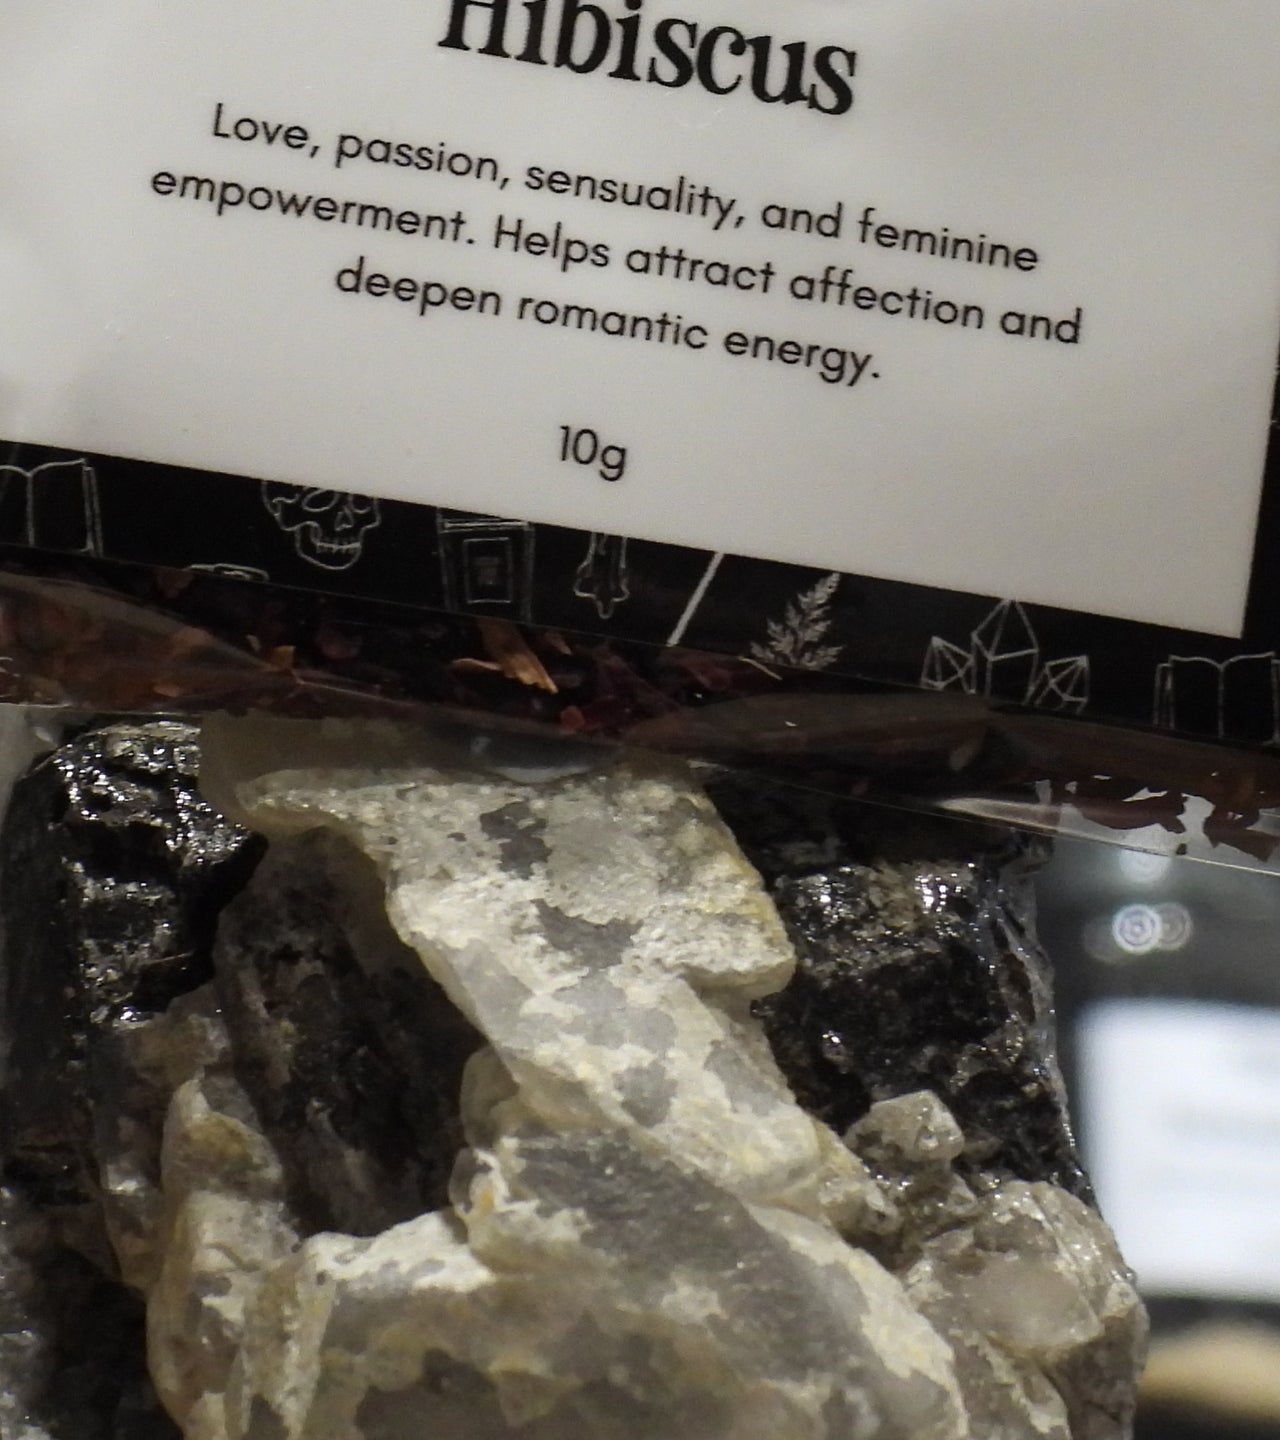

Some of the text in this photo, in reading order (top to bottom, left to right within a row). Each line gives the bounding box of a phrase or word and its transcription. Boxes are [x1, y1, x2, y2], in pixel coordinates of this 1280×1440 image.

[150, 171, 1084, 346] empowerment. Helps attract affection and
[211, 102, 1040, 274] Love, passion, sensuality, and feminine
[334, 255, 882, 388] deepen romantic energy.
[559, 424, 628, 484] 10g
